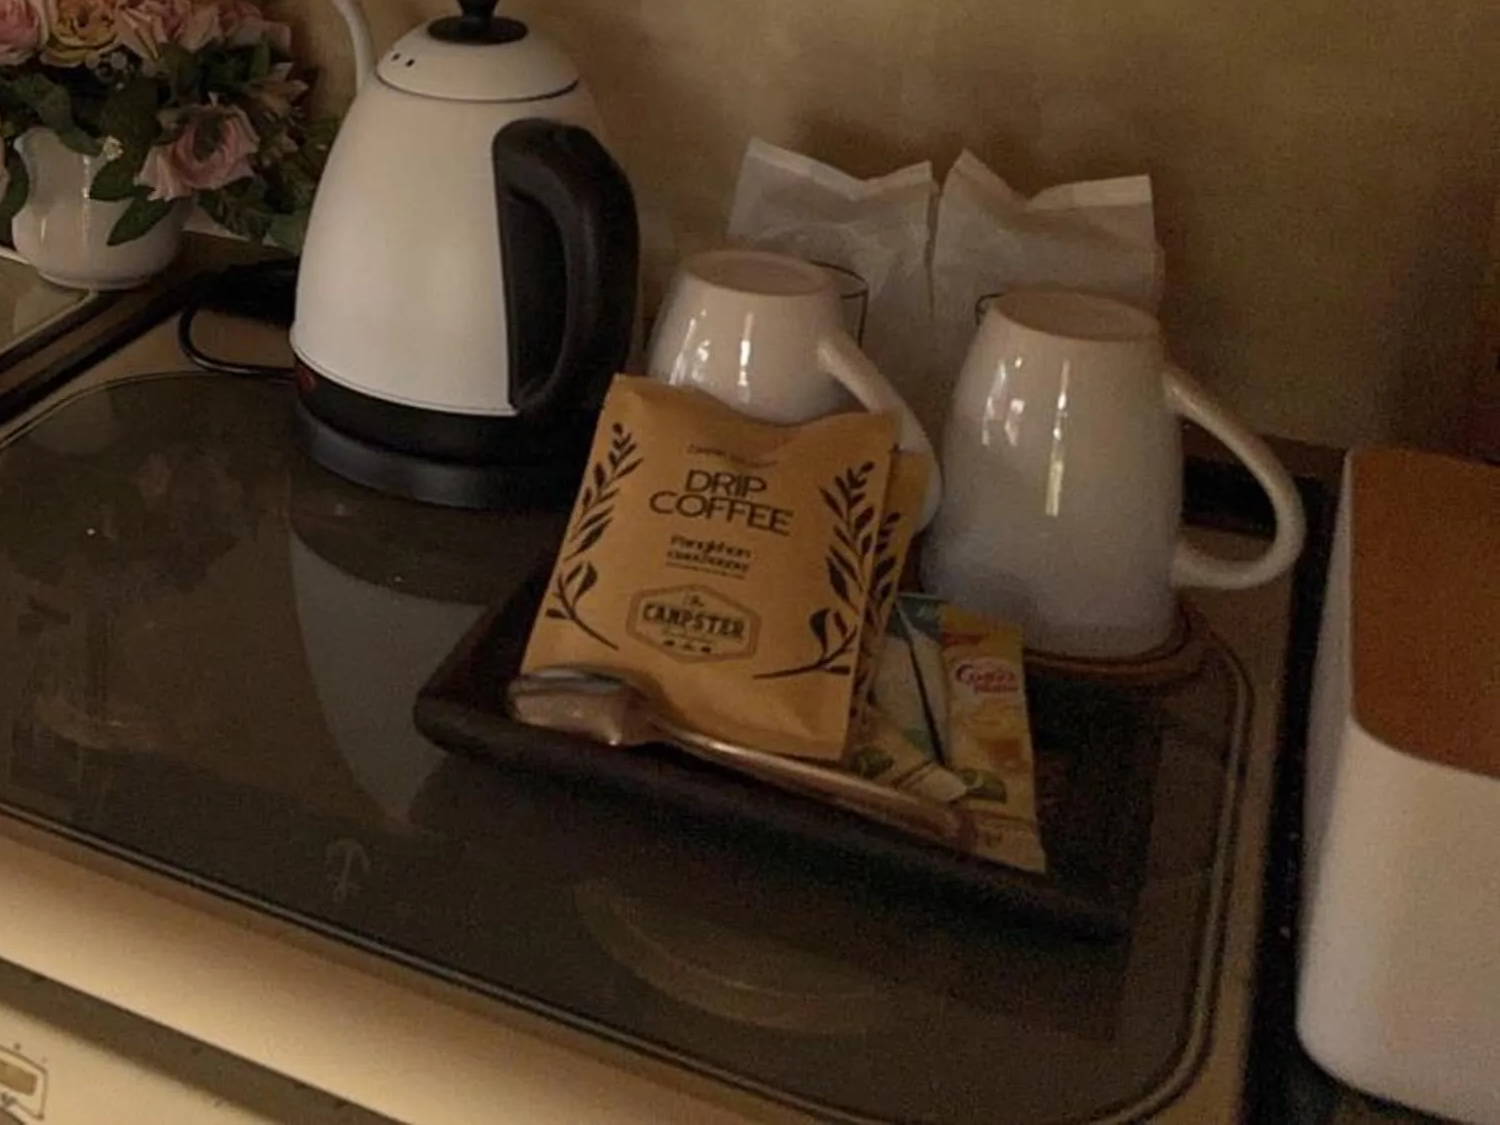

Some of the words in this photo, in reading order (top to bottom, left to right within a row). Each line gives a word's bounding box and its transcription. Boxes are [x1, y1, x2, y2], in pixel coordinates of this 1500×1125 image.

[685, 469, 768, 498] DRIP
[649, 491, 795, 537] COFFEE
[643, 603, 746, 639] CAMPSTER
